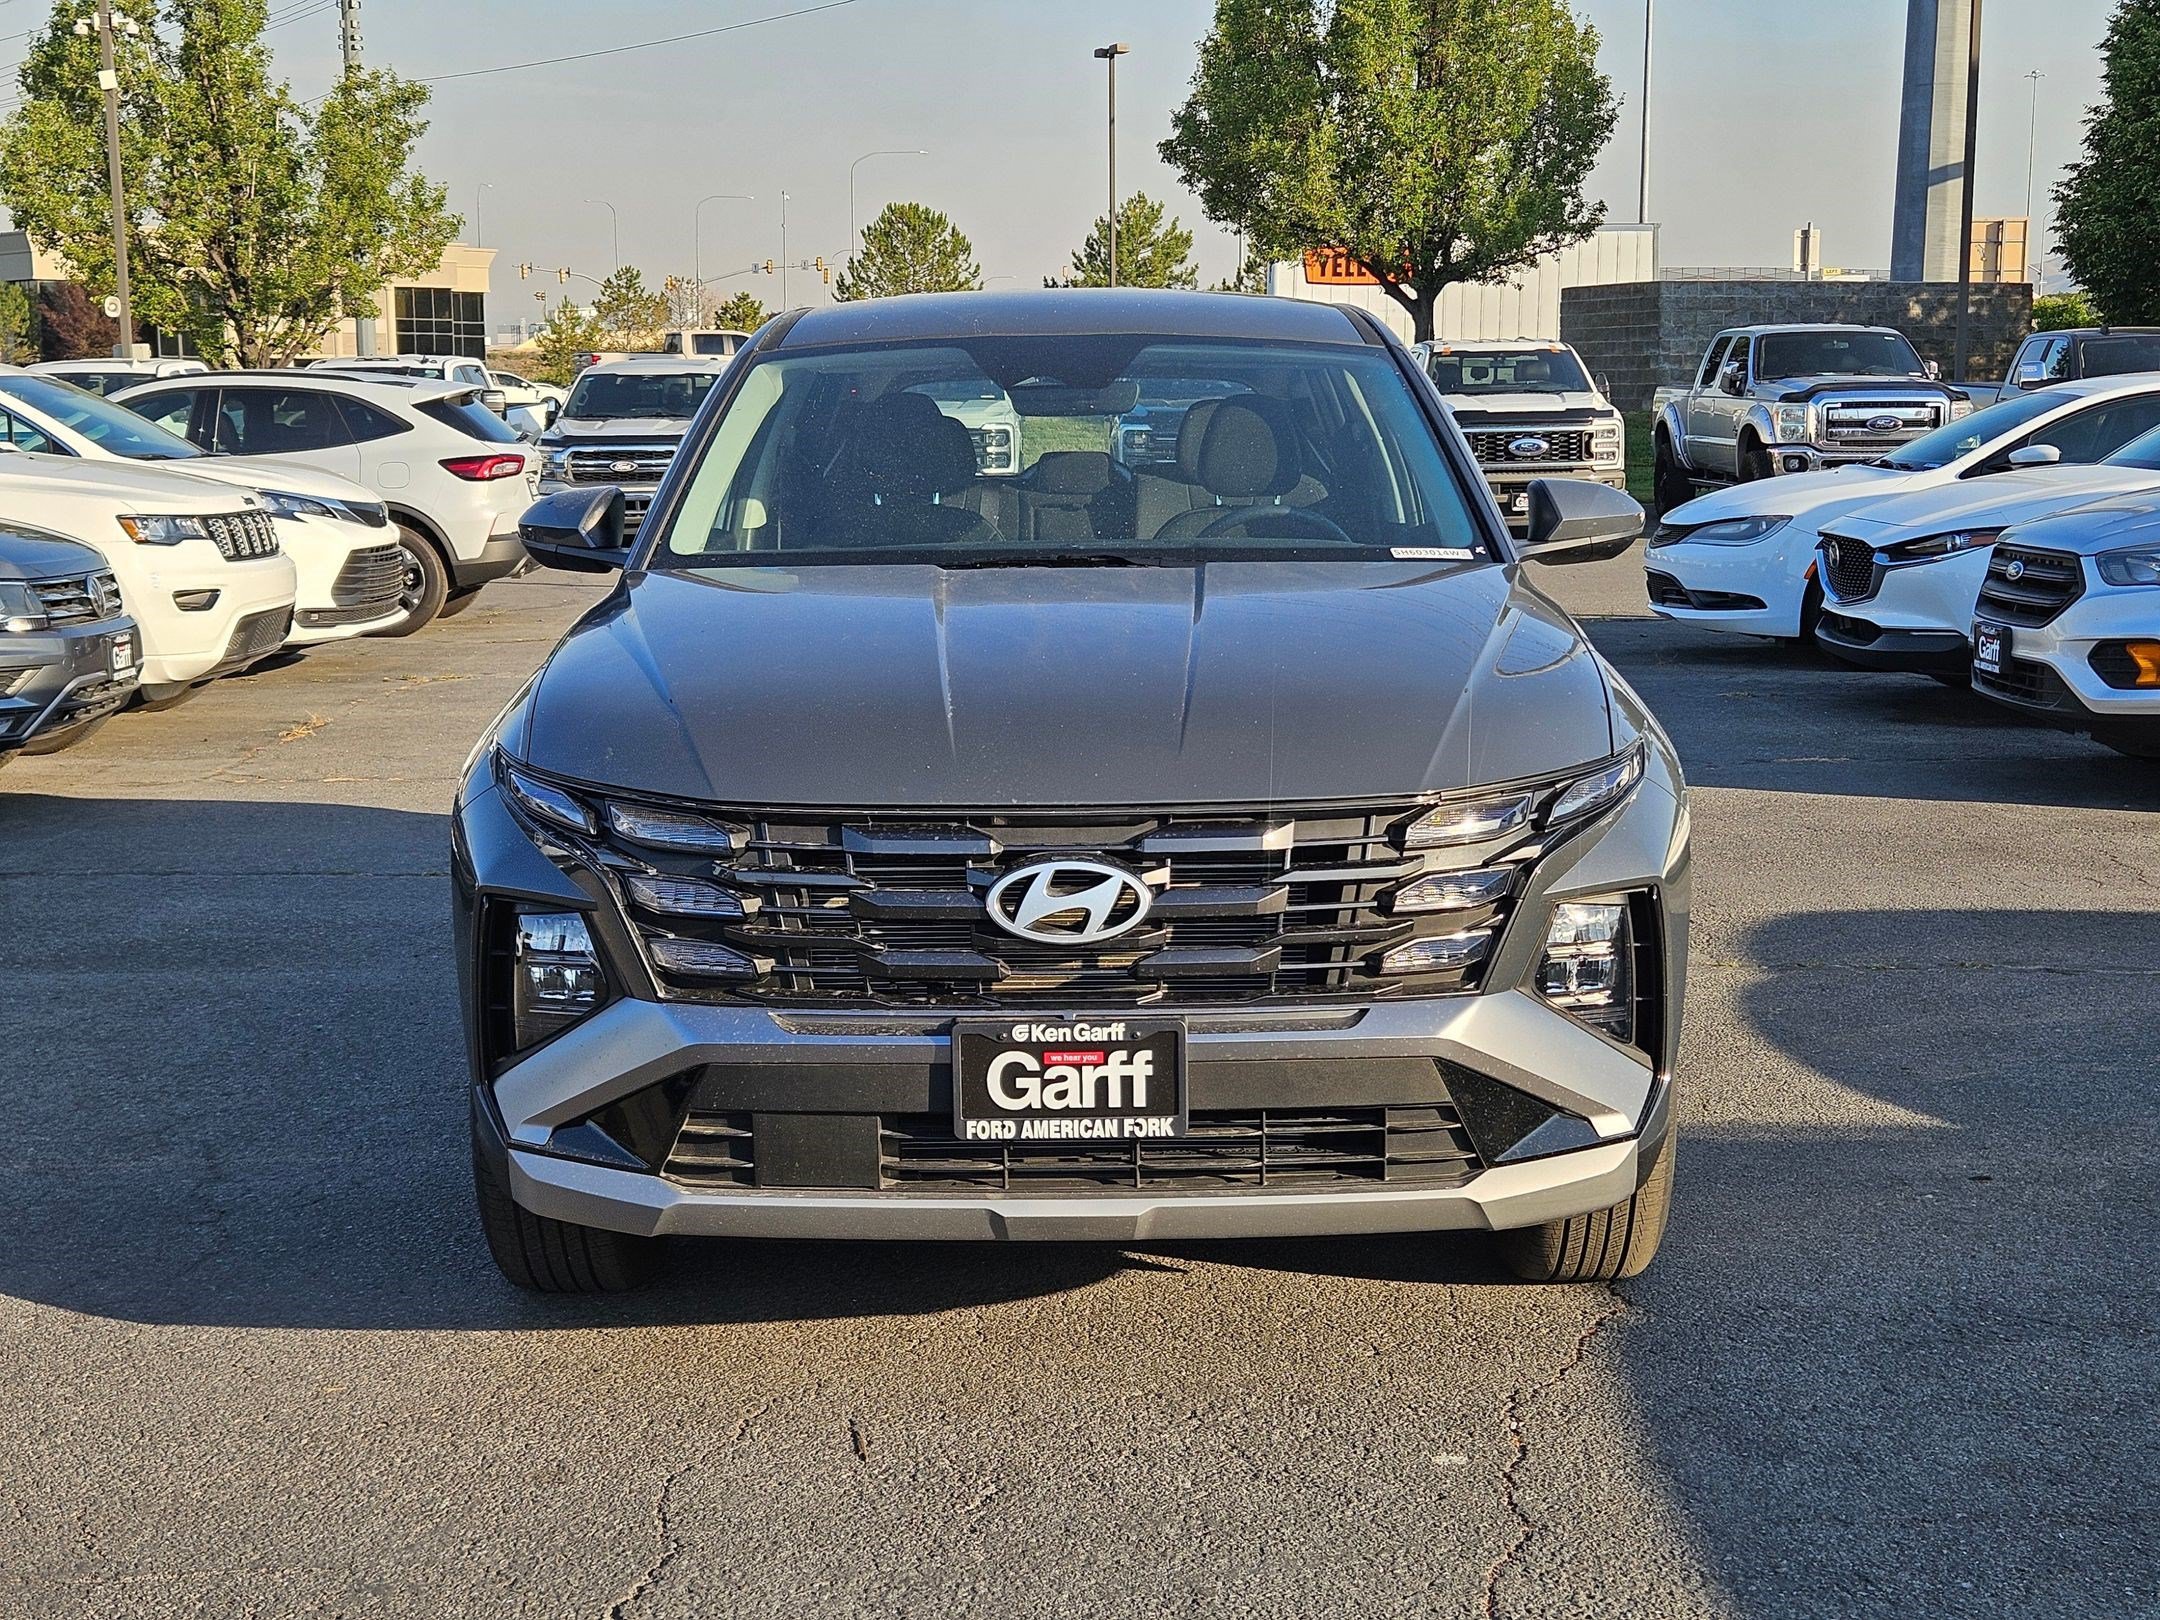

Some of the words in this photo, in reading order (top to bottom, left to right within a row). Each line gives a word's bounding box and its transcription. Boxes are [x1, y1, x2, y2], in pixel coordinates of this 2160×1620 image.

[1318, 255, 1367, 277] YELL
[1978, 635, 2001, 662] Garff
[1030, 1023, 1072, 1042] Ken
[1072, 1022, 1126, 1042] Garff
[1063, 1054, 1081, 1062] hear
[1082, 1055, 1098, 1063] you
[986, 1049, 1154, 1111] Garff
[966, 1119, 1016, 1140] FORD
[1020, 1119, 1118, 1139] AMERICAN
[1123, 1117, 1175, 1138] FORK
